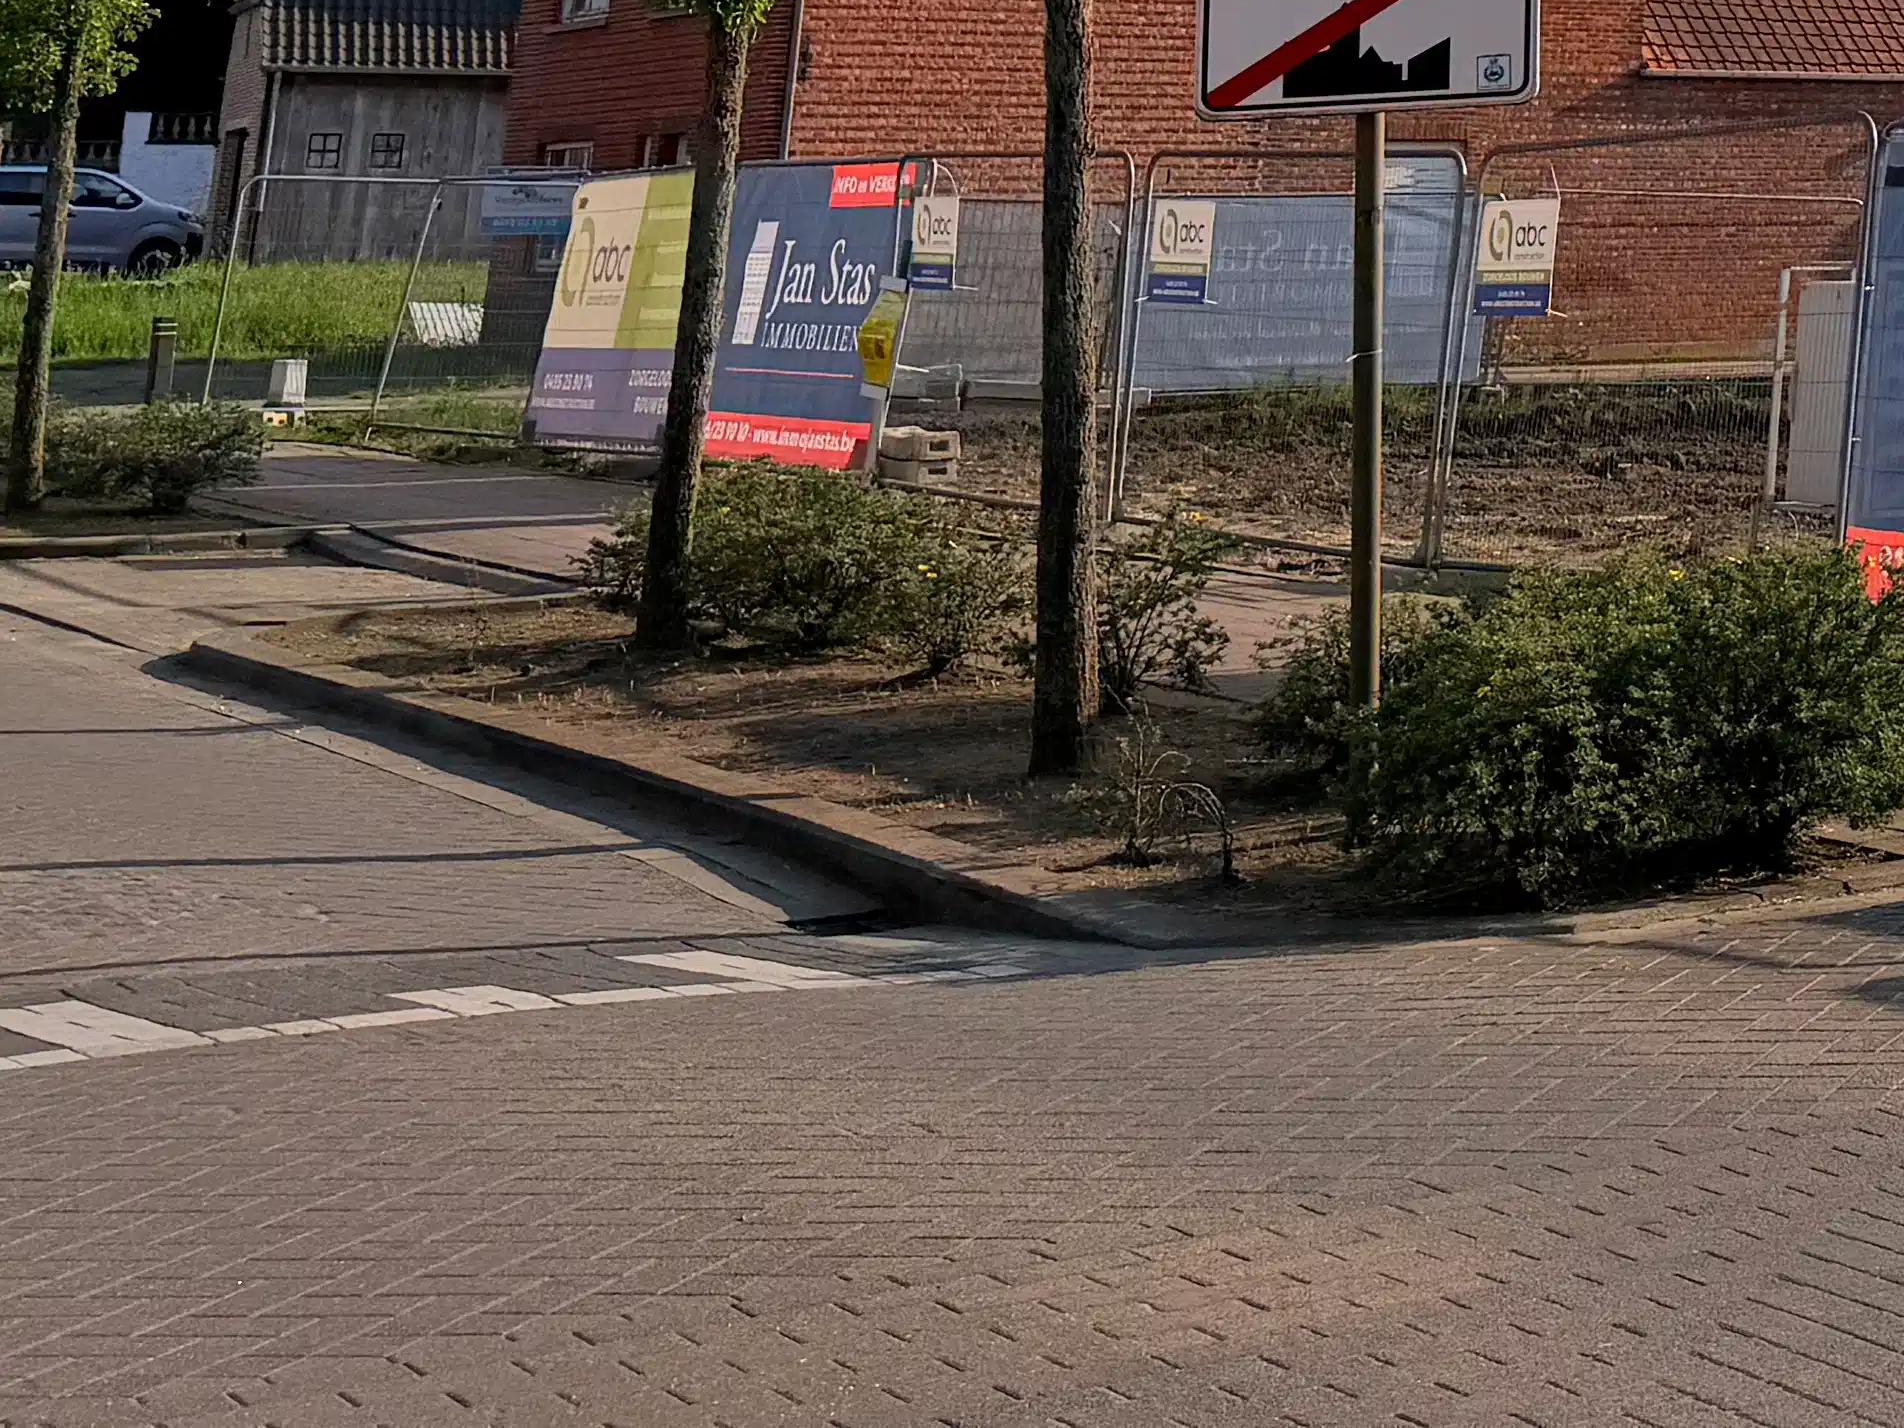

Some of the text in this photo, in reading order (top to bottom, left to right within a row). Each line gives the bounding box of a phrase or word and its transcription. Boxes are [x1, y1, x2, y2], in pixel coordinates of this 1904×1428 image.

[1180, 220, 1205, 243] abc
[1515, 221, 1547, 247] abc
[593, 236, 632, 283] abc
[765, 239, 876, 319] Jan Stas
[760, 322, 858, 352] IMMOBILIEN
